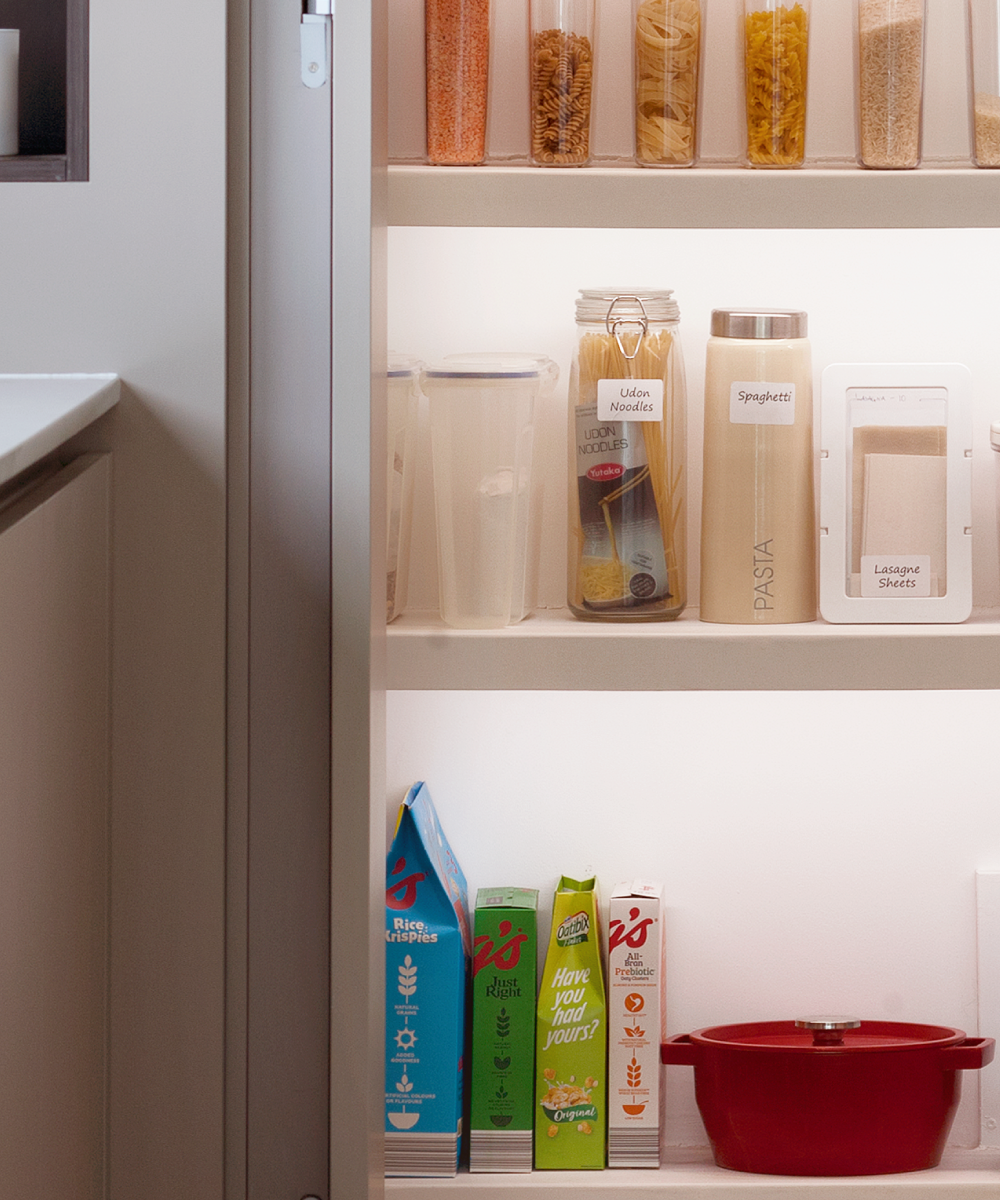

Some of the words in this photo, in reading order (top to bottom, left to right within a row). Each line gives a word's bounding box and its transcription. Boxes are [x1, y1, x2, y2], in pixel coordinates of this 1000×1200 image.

[620, 387, 650, 398] Udon
[738, 391, 792, 404] Spaghetti
[610, 401, 653, 411] Noodles
[584, 426, 616, 440] UDON
[578, 439, 629, 455] NOODLES
[590, 466, 621, 477] Yutaka
[753, 538, 774, 611] PASTA
[875, 565, 920, 577] Lasagne
[879, 578, 915, 588] Sheets
[393, 917, 424, 931] Rice
[557, 912, 589, 939] Oatibix
[626, 952, 643, 961] All-
[551, 967, 591, 988] Have
[615, 967, 654, 976] Prebiotic
[486, 983, 521, 1001] Right
[493, 976, 518, 993] Just
[551, 987, 586, 1011] you
[552, 1001, 588, 1027] had
[542, 1019, 600, 1052] yours?
[553, 1106, 596, 1122] Original
